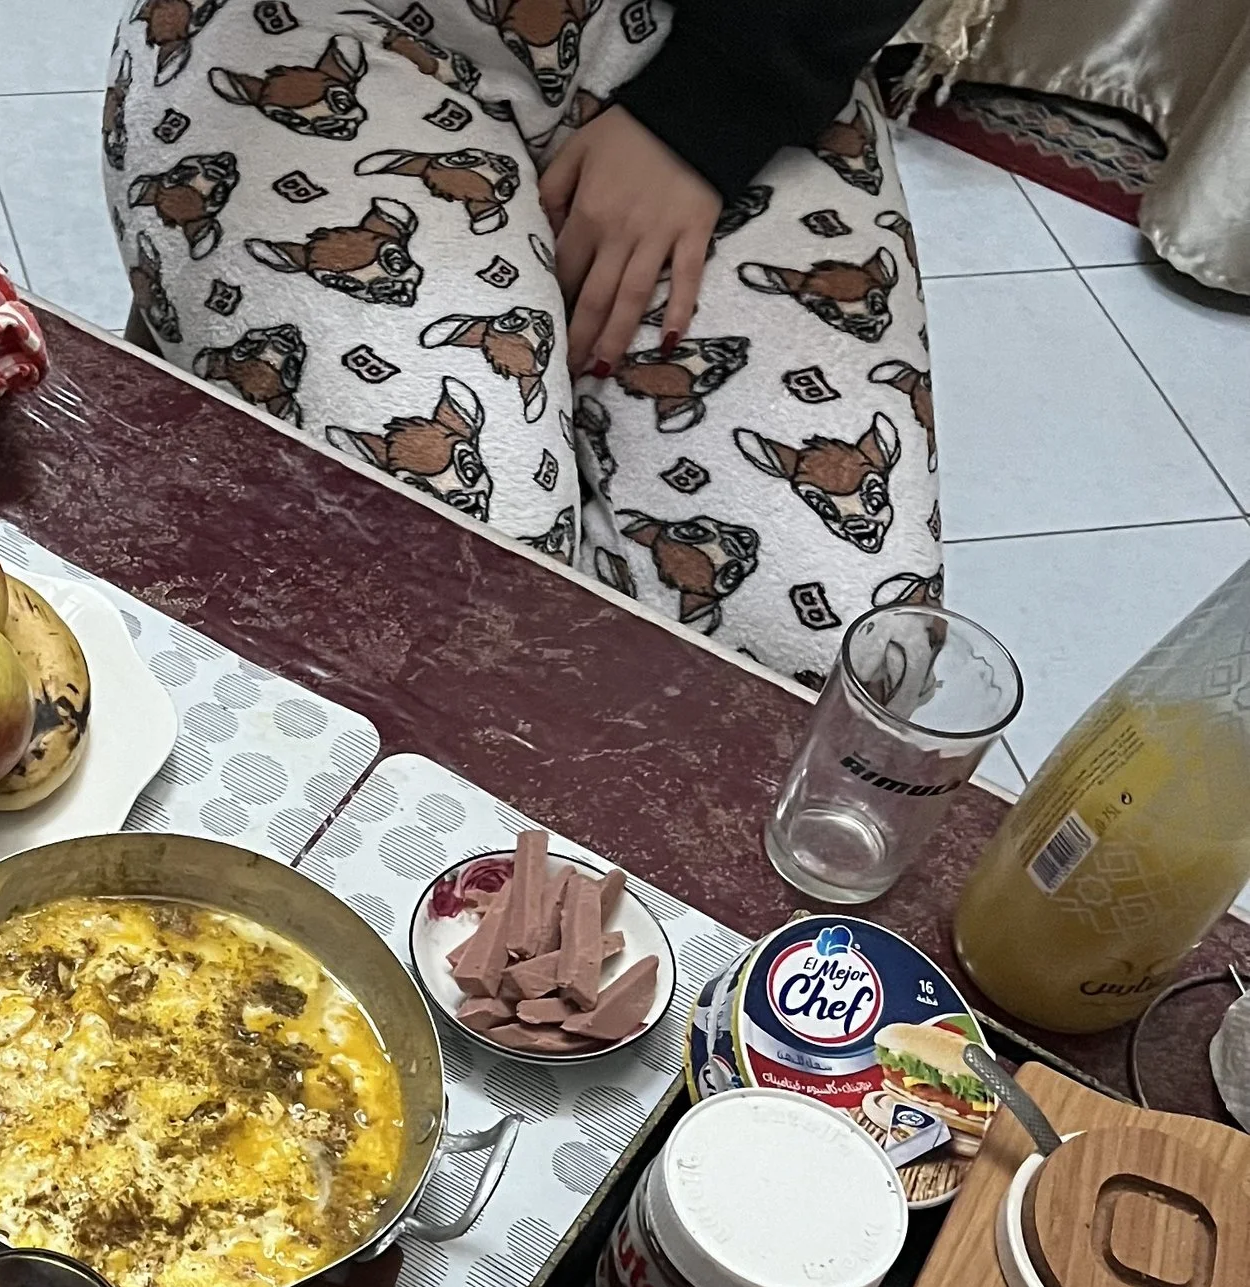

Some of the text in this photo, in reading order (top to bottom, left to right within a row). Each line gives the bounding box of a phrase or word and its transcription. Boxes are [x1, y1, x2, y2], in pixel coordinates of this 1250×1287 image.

[803, 957, 869, 991] El Mejor
[916, 993, 939, 1007] قطعة
[919, 979, 935, 996] 16
[778, 973, 874, 1035] Chef
